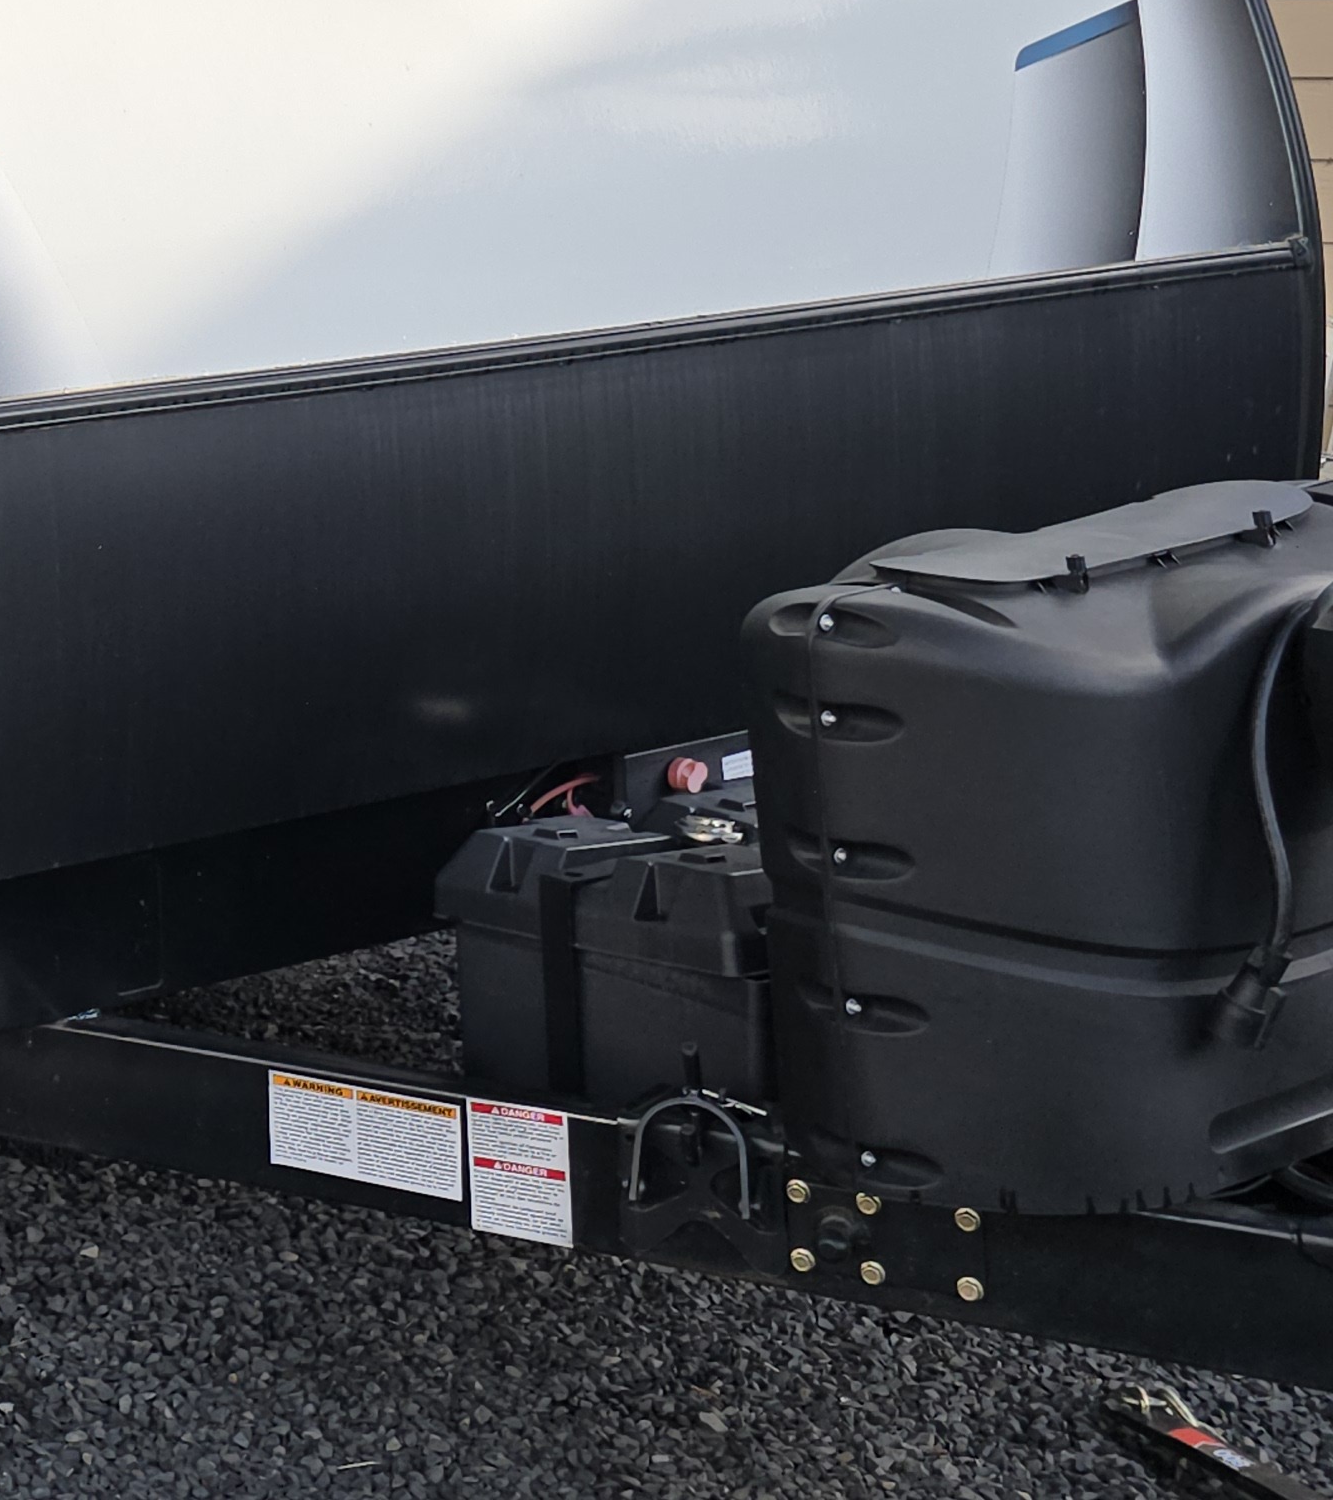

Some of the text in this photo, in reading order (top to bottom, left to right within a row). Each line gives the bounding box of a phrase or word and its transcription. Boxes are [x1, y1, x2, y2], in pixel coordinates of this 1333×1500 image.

[293, 1078, 344, 1097] WARNING
[369, 1093, 454, 1117] AVERTISSEMENT
[500, 1107, 545, 1122] DANGER
[503, 1162, 548, 1177] DANGER
